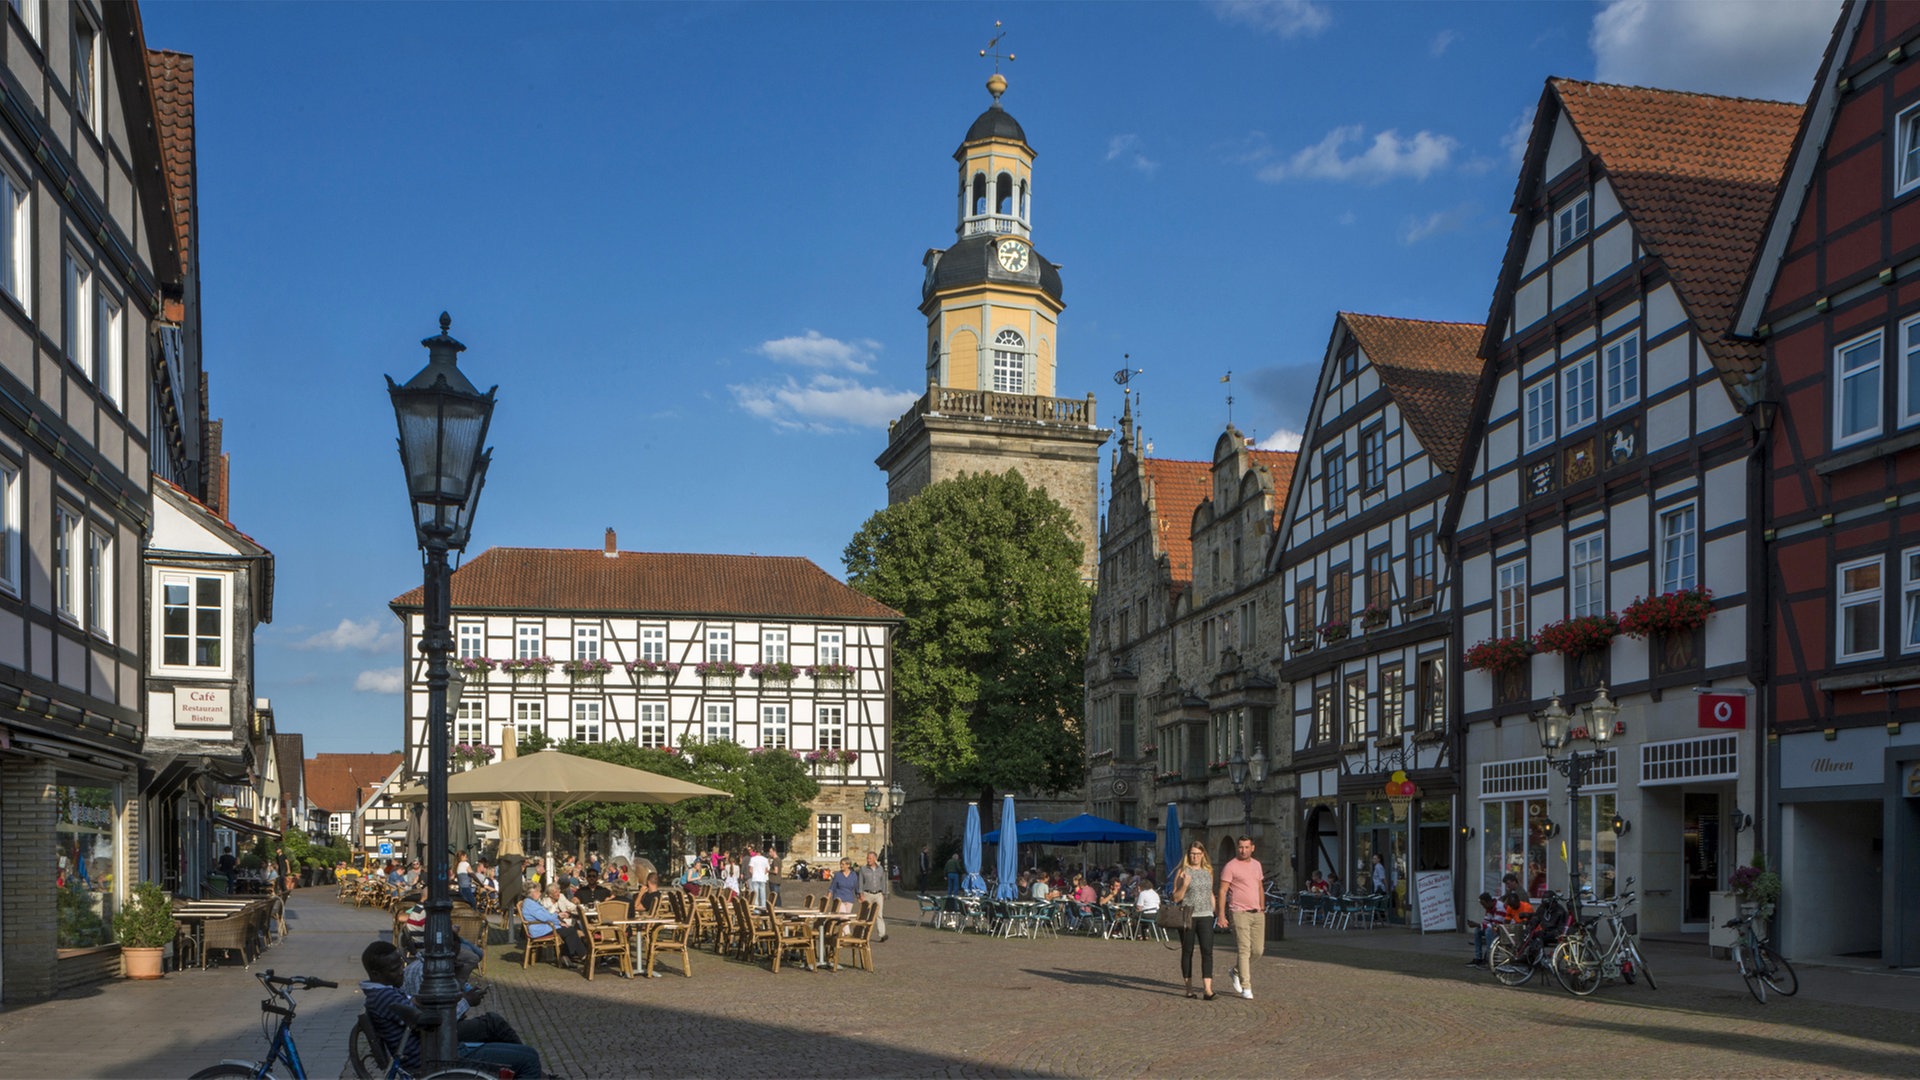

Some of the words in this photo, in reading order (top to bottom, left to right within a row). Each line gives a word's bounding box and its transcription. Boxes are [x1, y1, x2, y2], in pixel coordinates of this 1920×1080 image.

[190, 692, 215, 701] Café
[182, 704, 224, 712] Restaurant
[1810, 757, 1854, 772] Uhren
